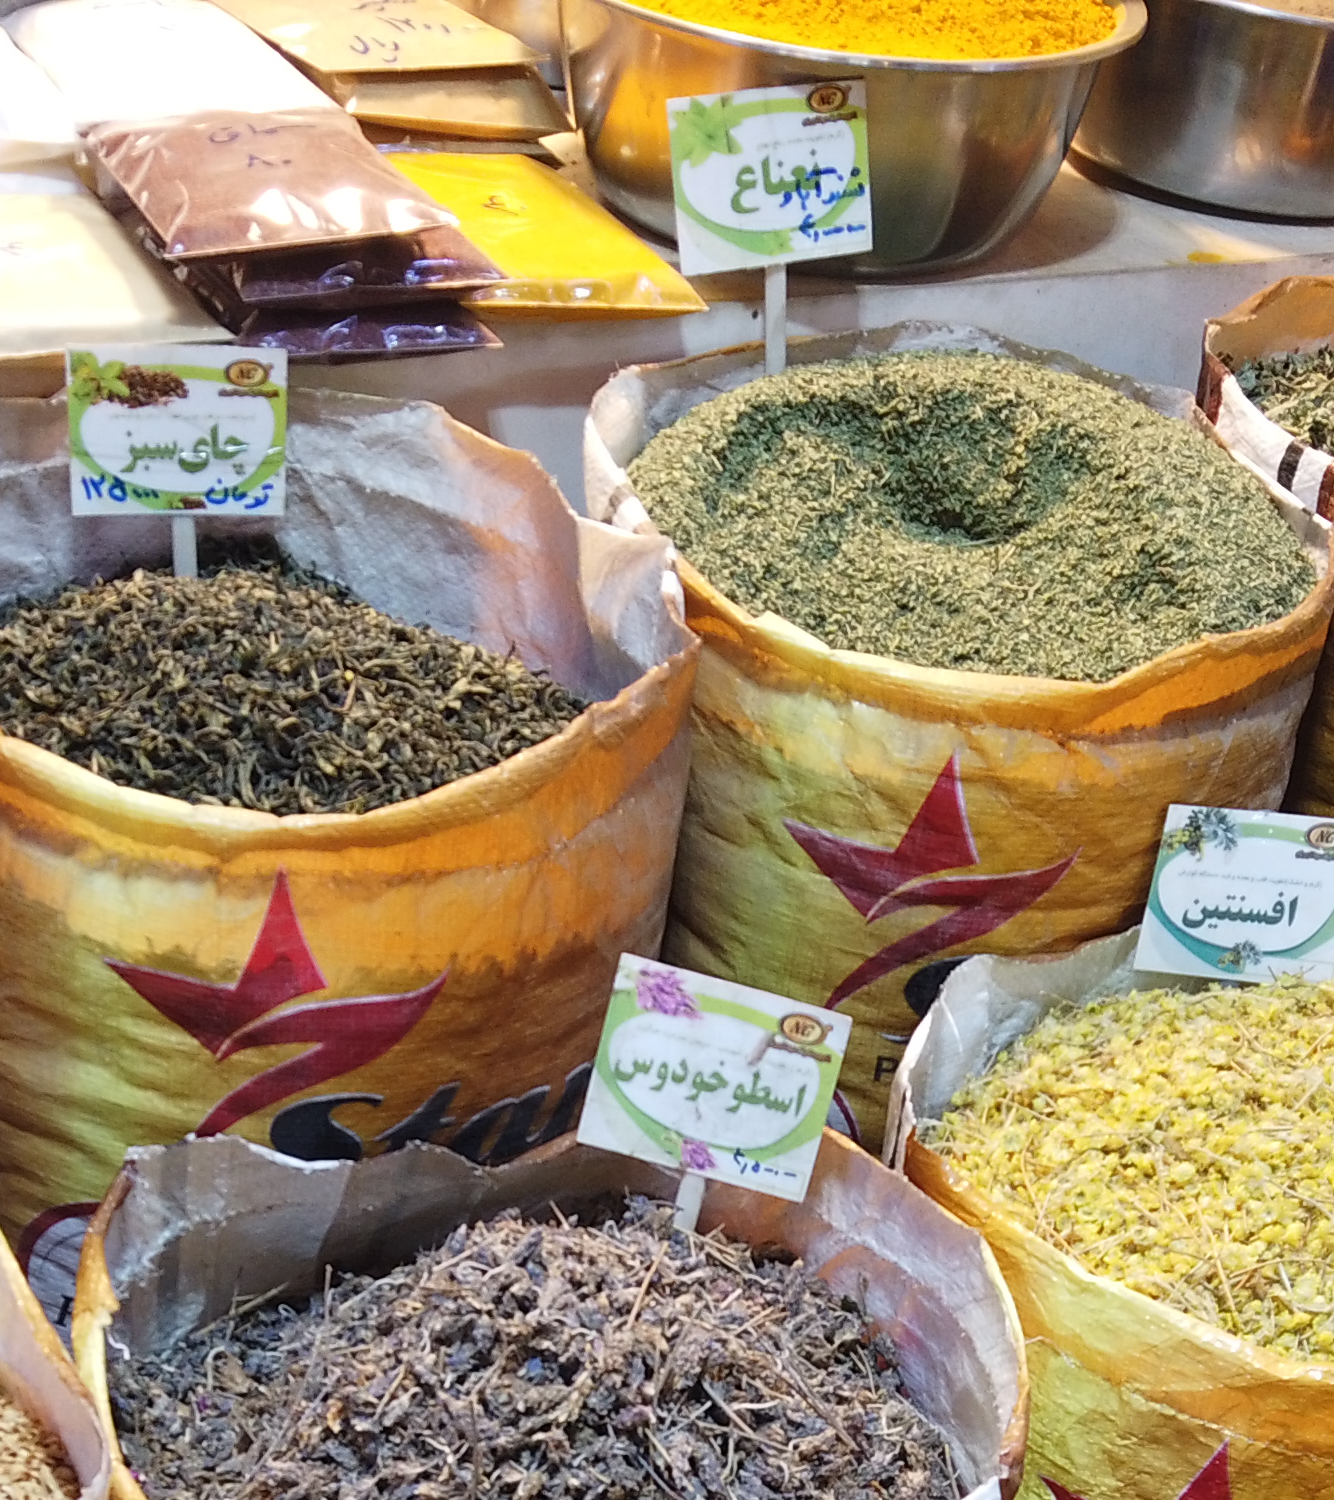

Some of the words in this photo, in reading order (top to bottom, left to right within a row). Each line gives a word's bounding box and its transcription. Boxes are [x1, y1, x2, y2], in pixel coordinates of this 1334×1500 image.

[119, 430, 178, 473] سبز
[178, 423, 250, 476] چای
[1181, 891, 1300, 929] افسنتین
